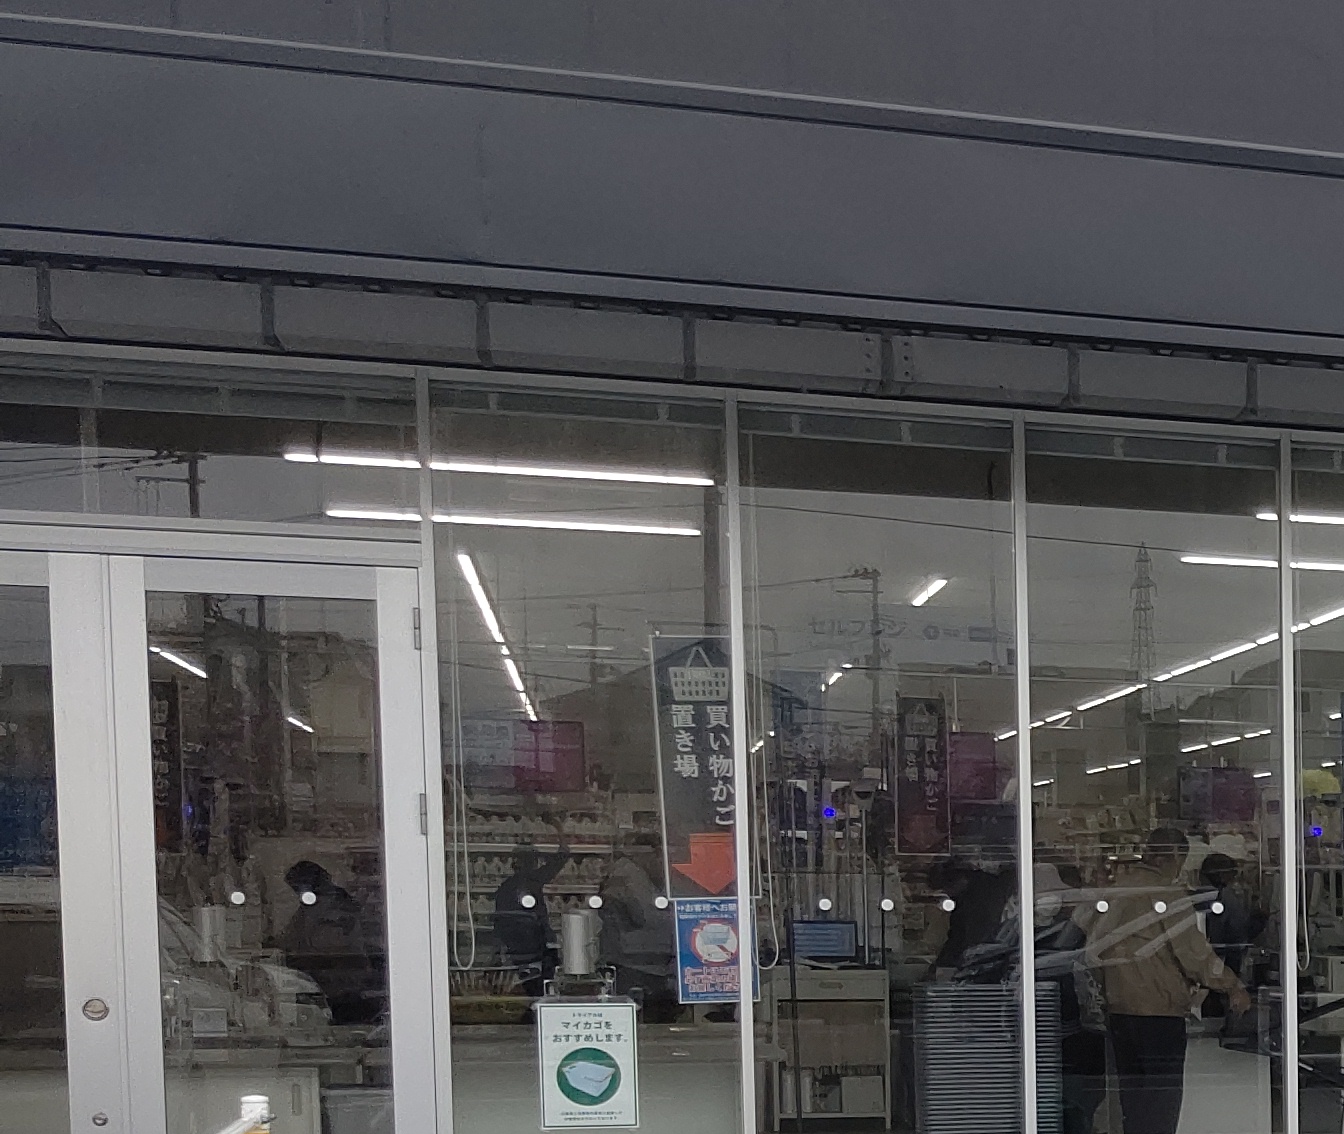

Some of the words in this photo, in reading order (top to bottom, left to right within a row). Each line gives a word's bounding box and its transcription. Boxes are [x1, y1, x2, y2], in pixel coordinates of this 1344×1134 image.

[671, 704, 699, 778] 置き場
[706, 705, 735, 826] 買い物かご
[552, 1034, 629, 1043] おすすめします。
[561, 1021, 613, 1030] マイカゴを
